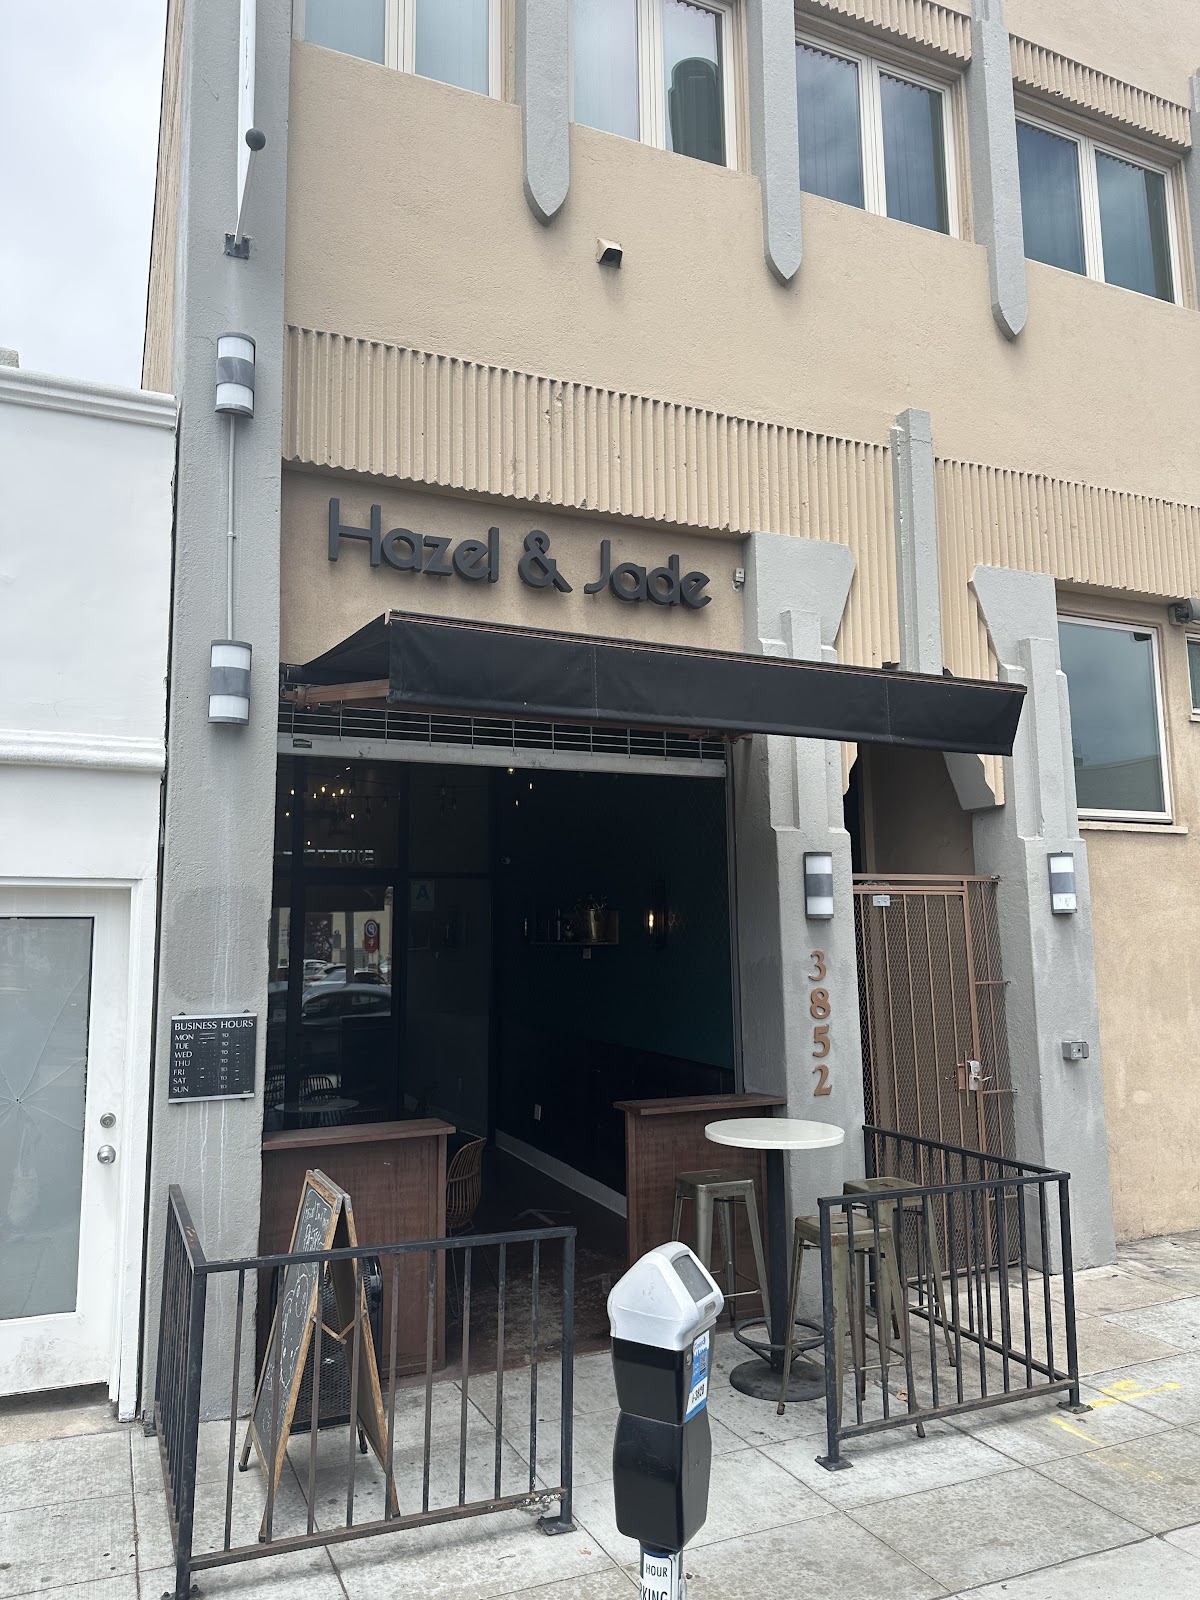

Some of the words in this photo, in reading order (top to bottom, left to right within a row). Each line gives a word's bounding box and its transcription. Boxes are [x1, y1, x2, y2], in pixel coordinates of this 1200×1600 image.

[328, 497, 500, 583] Hazel
[518, 530, 573, 593] &
[584, 539, 712, 609] Jade
[174, 1021, 217, 1031] BUSINESS
[220, 1020, 254, 1029] HOURS
[808, 950, 833, 1097] 3852
[174, 1033, 194, 1041] MON
[175, 1042, 189, 1050] TUE
[174, 1051, 193, 1059] WED
[173, 1068, 185, 1076] FRI
[173, 1077, 187, 1085] SAT
[172, 1086, 189, 1094] SUN
[646, 1563, 668, 1577] HOUR
